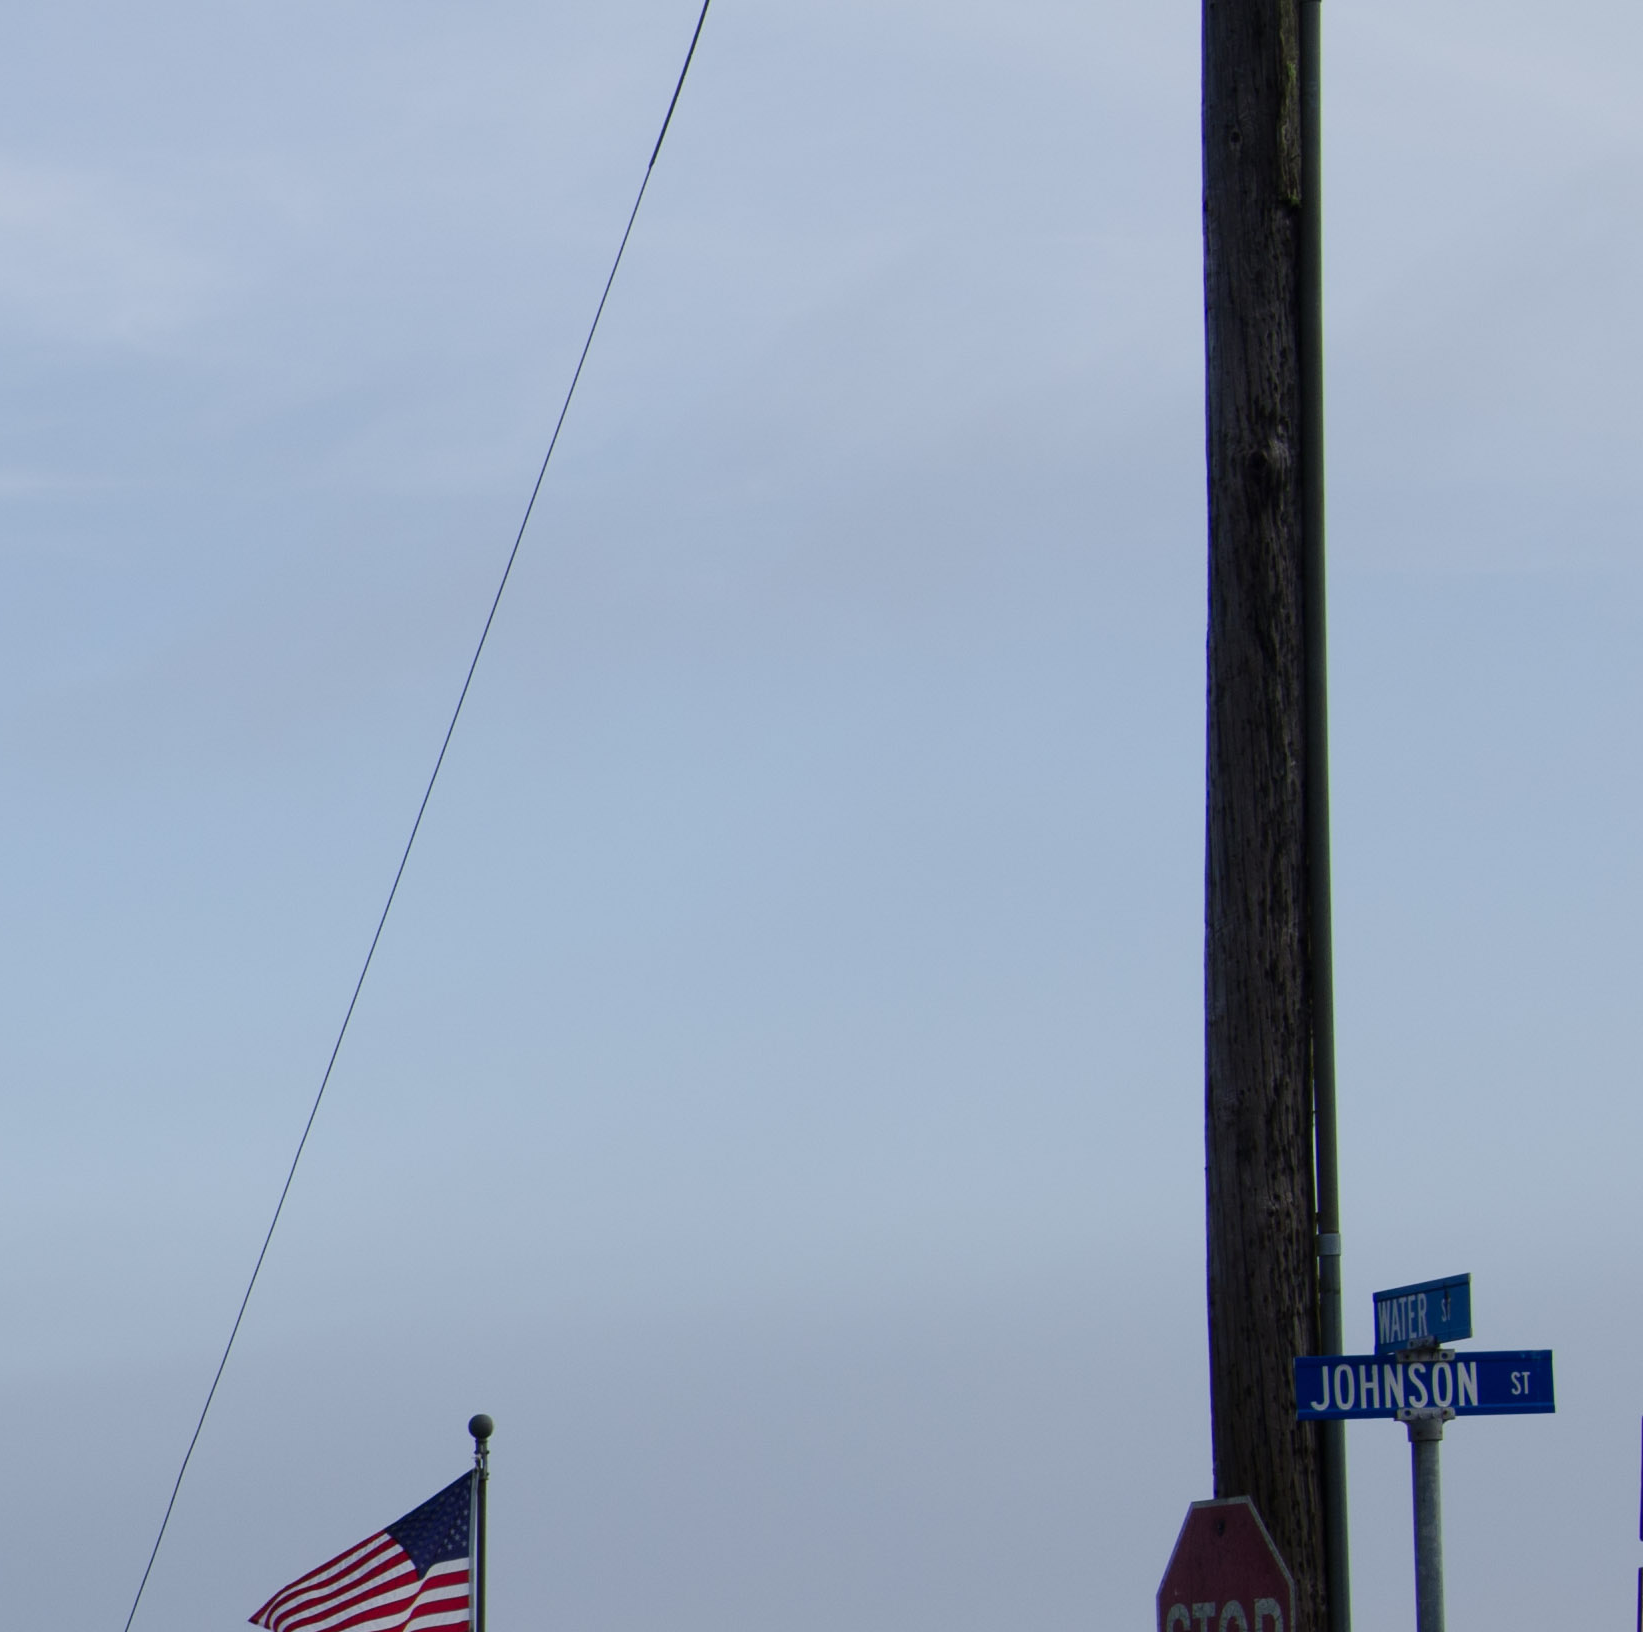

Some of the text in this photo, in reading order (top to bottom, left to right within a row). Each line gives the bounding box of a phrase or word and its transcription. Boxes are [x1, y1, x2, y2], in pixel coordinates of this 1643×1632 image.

[1377, 1293, 1428, 1345] WATER
[1310, 1361, 1531, 1411] JOHNSON ST
